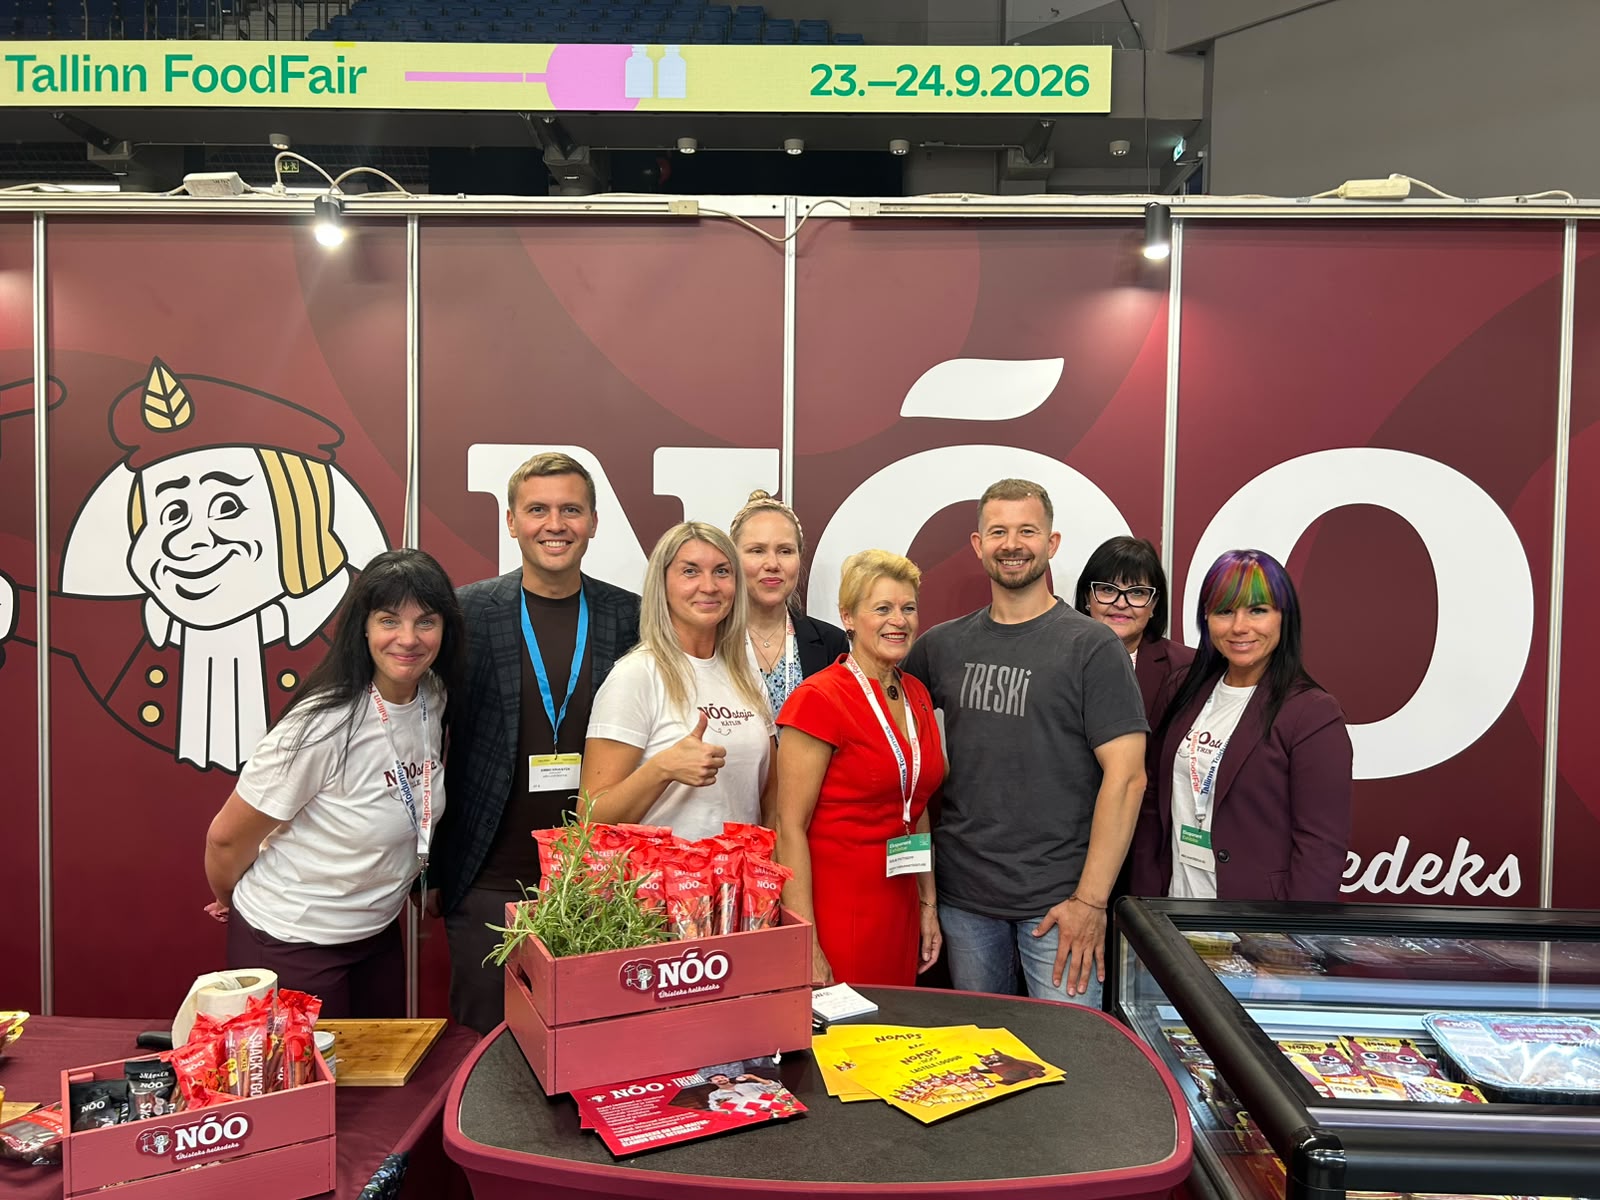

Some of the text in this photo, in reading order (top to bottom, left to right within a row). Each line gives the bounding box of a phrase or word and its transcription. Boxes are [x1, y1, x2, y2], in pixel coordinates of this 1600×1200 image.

[5, 54, 367, 94] Tallinn FoodFair
[1339, 835, 1522, 898] edeks
[81, 1100, 106, 1113] NÕO
